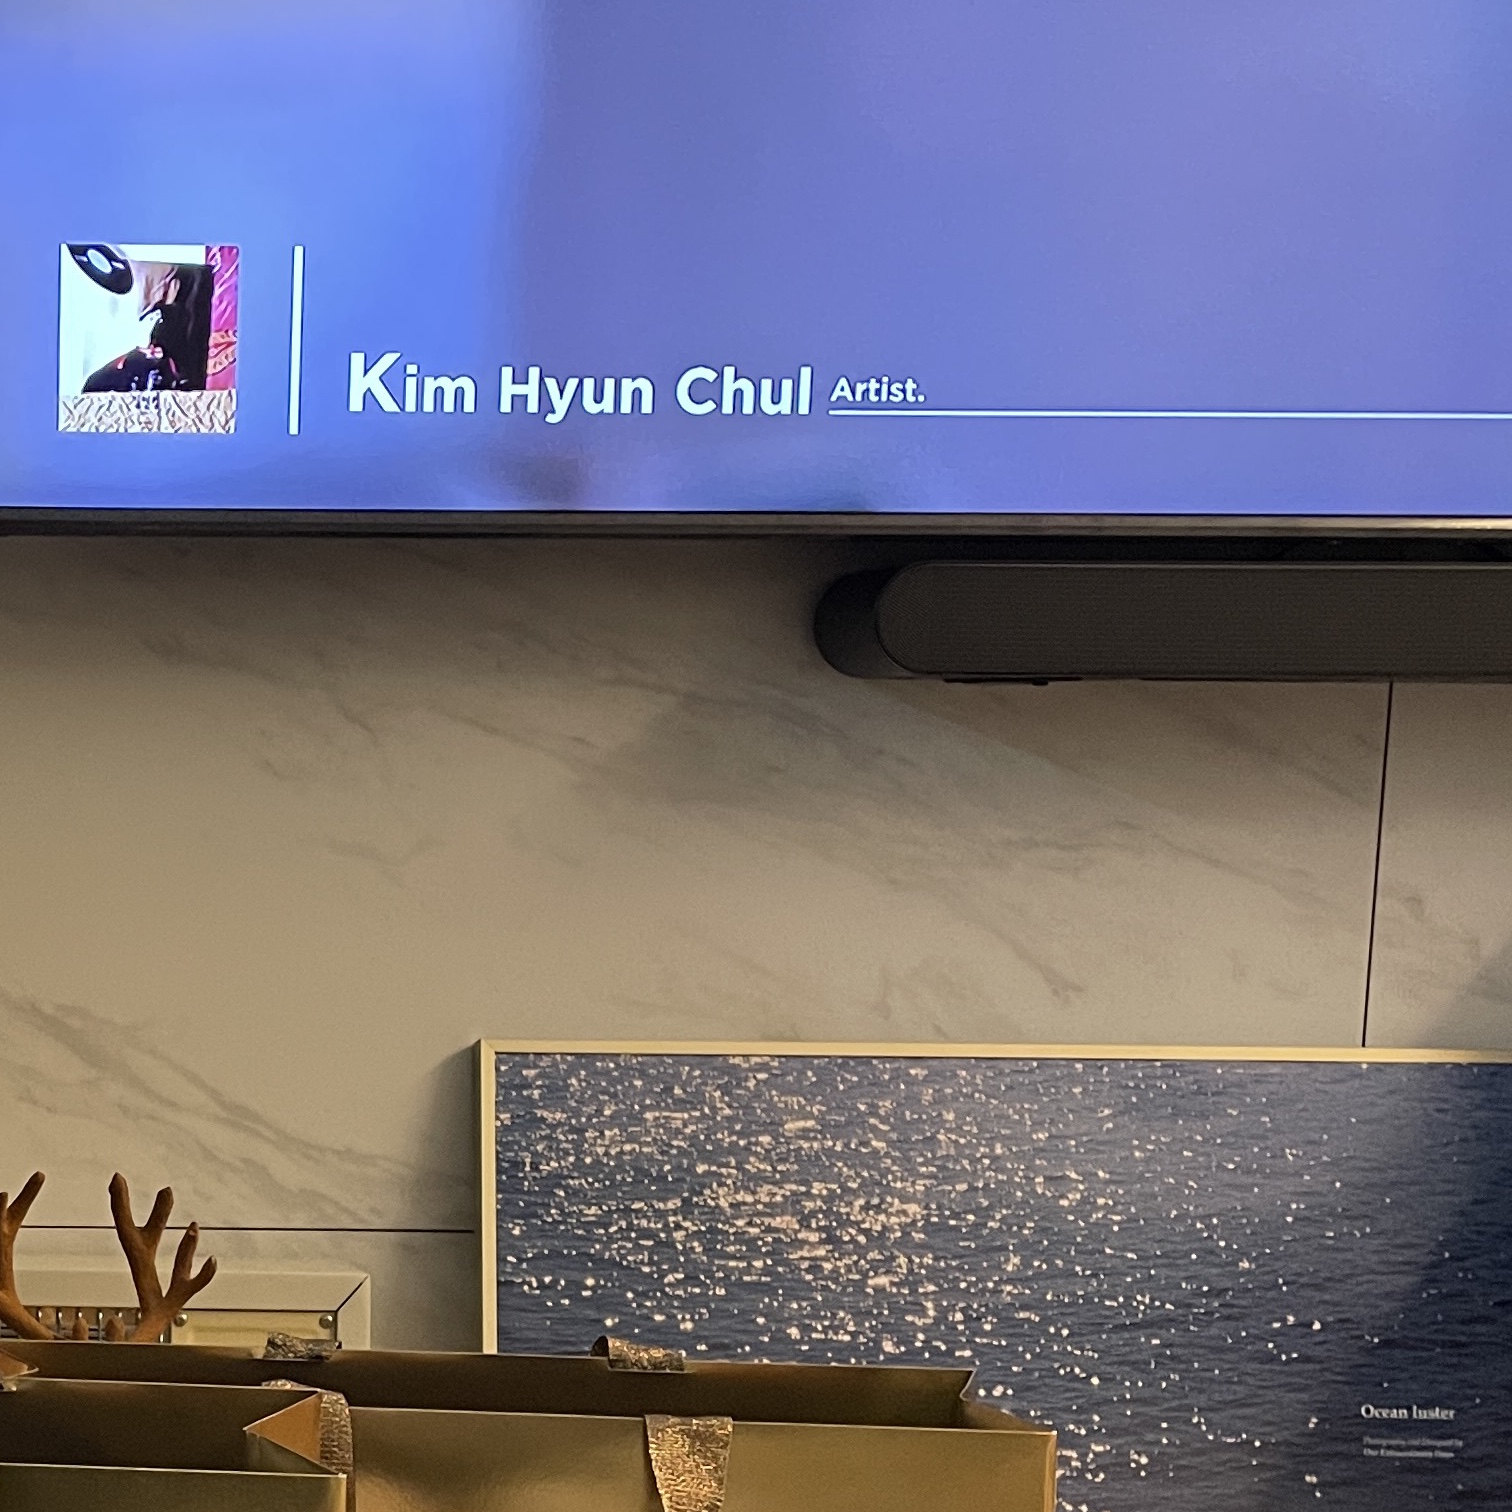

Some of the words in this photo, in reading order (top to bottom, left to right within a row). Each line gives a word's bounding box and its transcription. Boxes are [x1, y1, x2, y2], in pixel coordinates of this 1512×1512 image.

[347, 350, 476, 413] Kim
[500, 366, 654, 426] Hyun
[675, 365, 813, 416] Chul
[830, 378, 926, 404] Artist.
[1360, 1403, 1408, 1419] Ocean
[1412, 1404, 1455, 1420] luster
